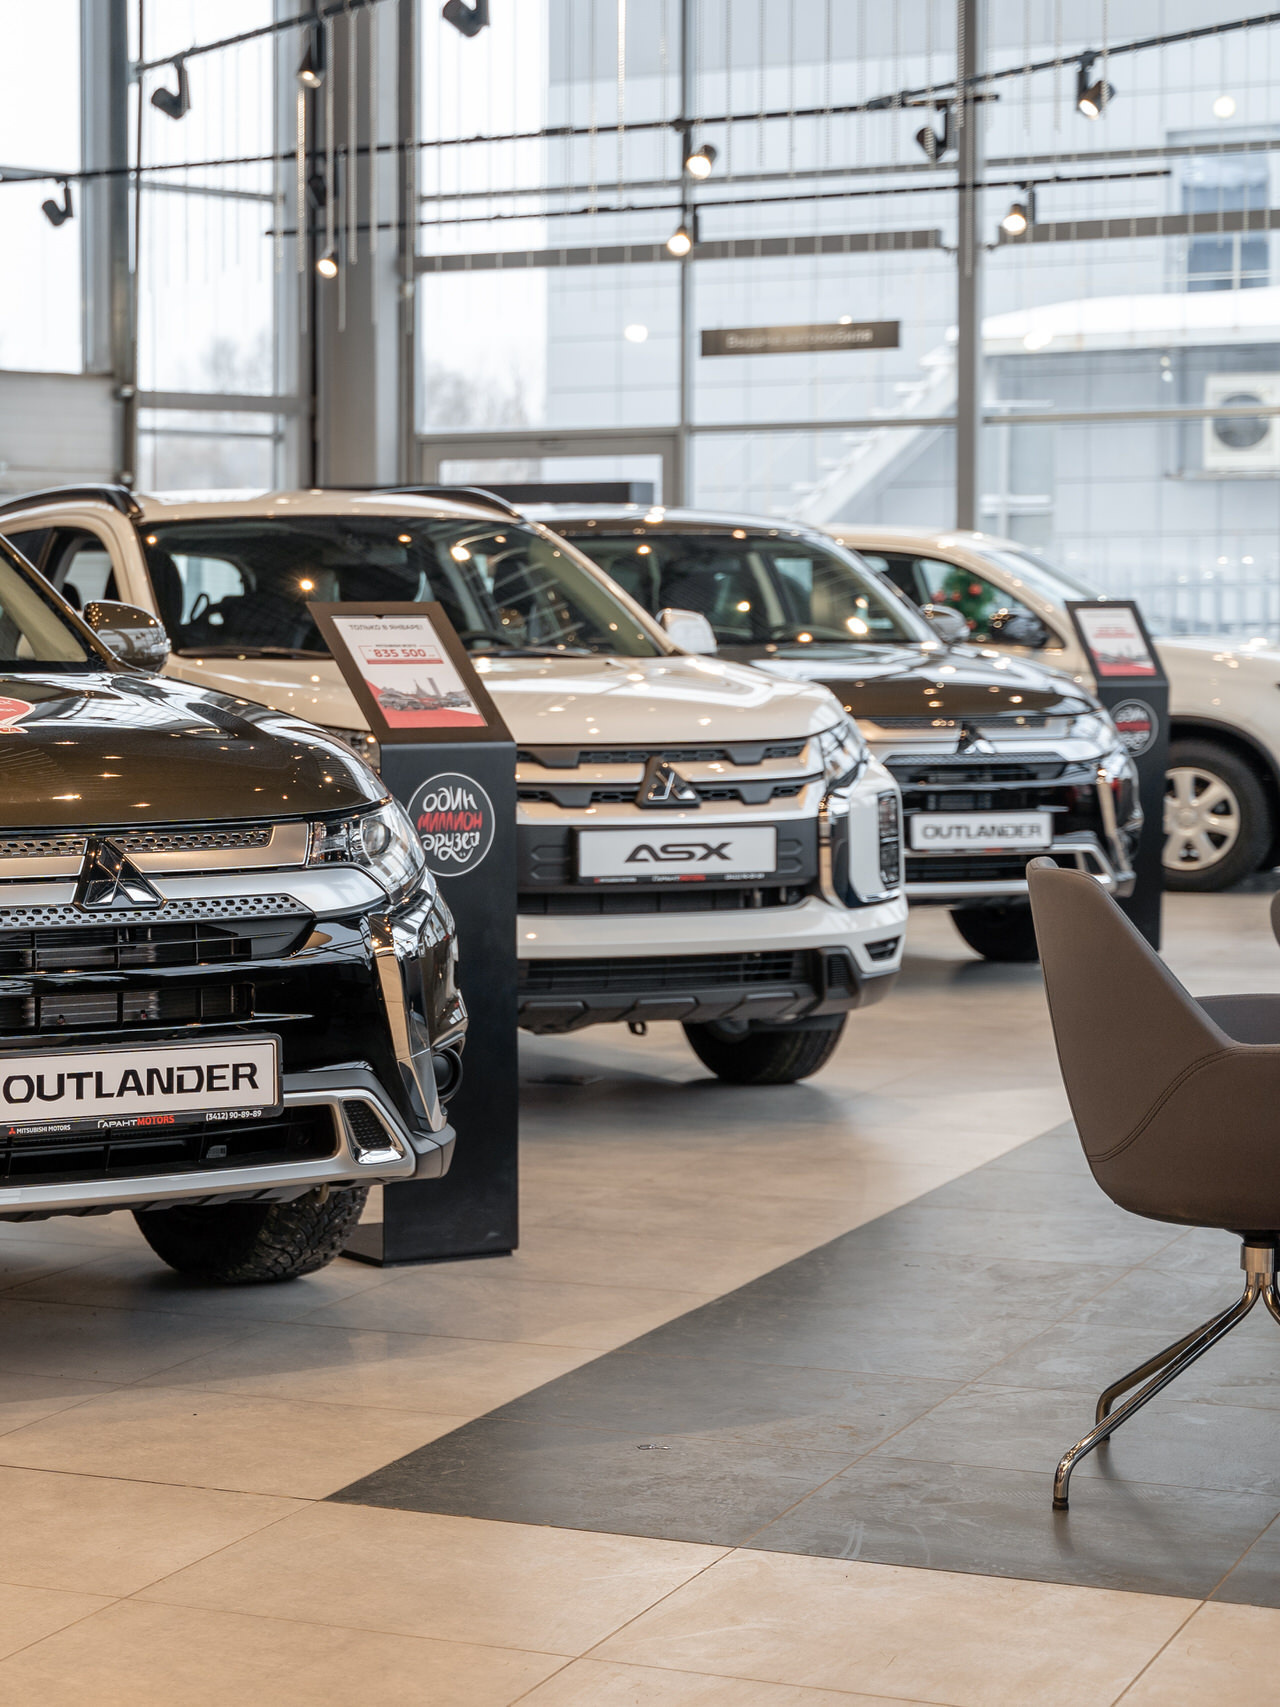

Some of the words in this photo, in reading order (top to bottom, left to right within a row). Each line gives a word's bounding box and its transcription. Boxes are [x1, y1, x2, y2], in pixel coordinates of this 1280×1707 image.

[373, 648, 399, 658] 835
[401, 648, 426, 658] 500
[922, 823, 1042, 839] OUTLANDER
[624, 841, 733, 864] ASX
[2, 1061, 260, 1105] OUTLANDER
[205, 1112, 228, 1121] (3412)
[229, 1109, 262, 1119] 90-89-89
[16, 1126, 48, 1134] MITSUBISHI
[48, 1124, 71, 1132] MOTORS
